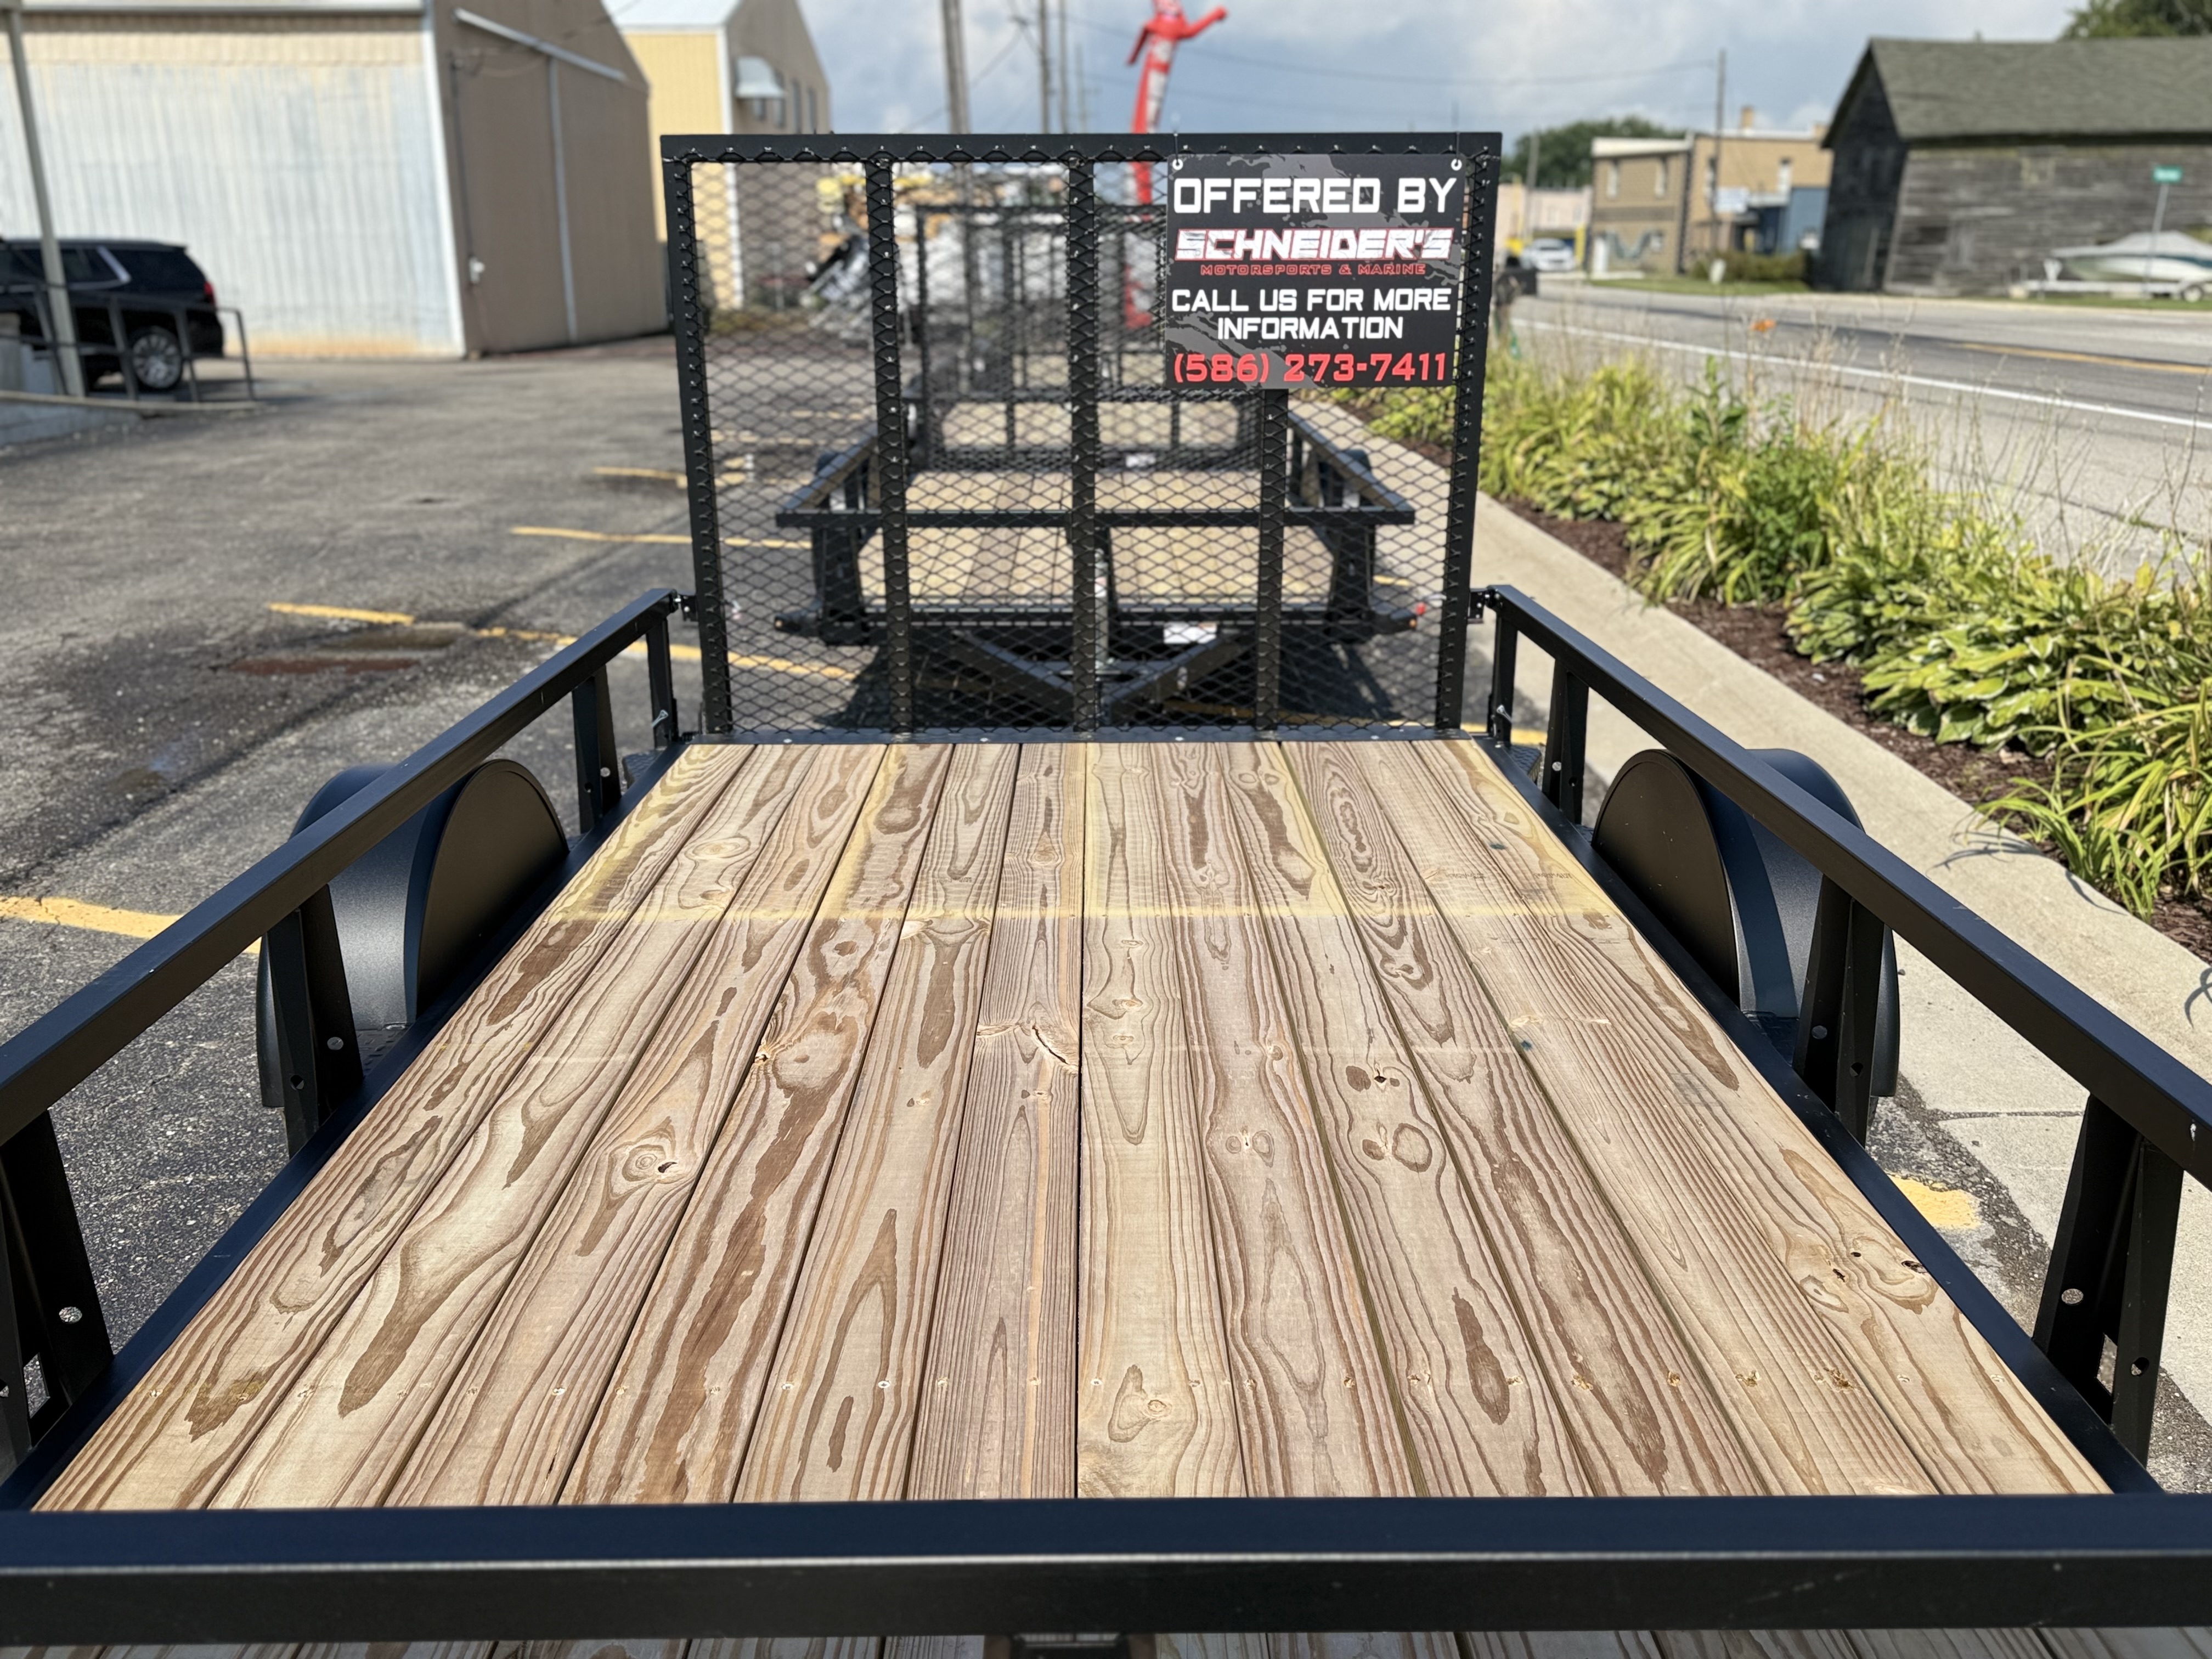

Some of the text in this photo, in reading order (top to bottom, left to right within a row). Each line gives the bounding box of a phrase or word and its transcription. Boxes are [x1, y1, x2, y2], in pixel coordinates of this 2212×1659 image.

[1173, 177, 1457, 214] OFFERED BY
[1175, 228, 1454, 261] SCHNEIDER'S
[1200, 264, 1425, 275] MOTORSPORTS & MARINE
[1172, 288, 1452, 312] CALL US FOR MORE
[1217, 317, 1403, 340] INFORMATION
[1173, 352, 1446, 383] (586) 273-7411
